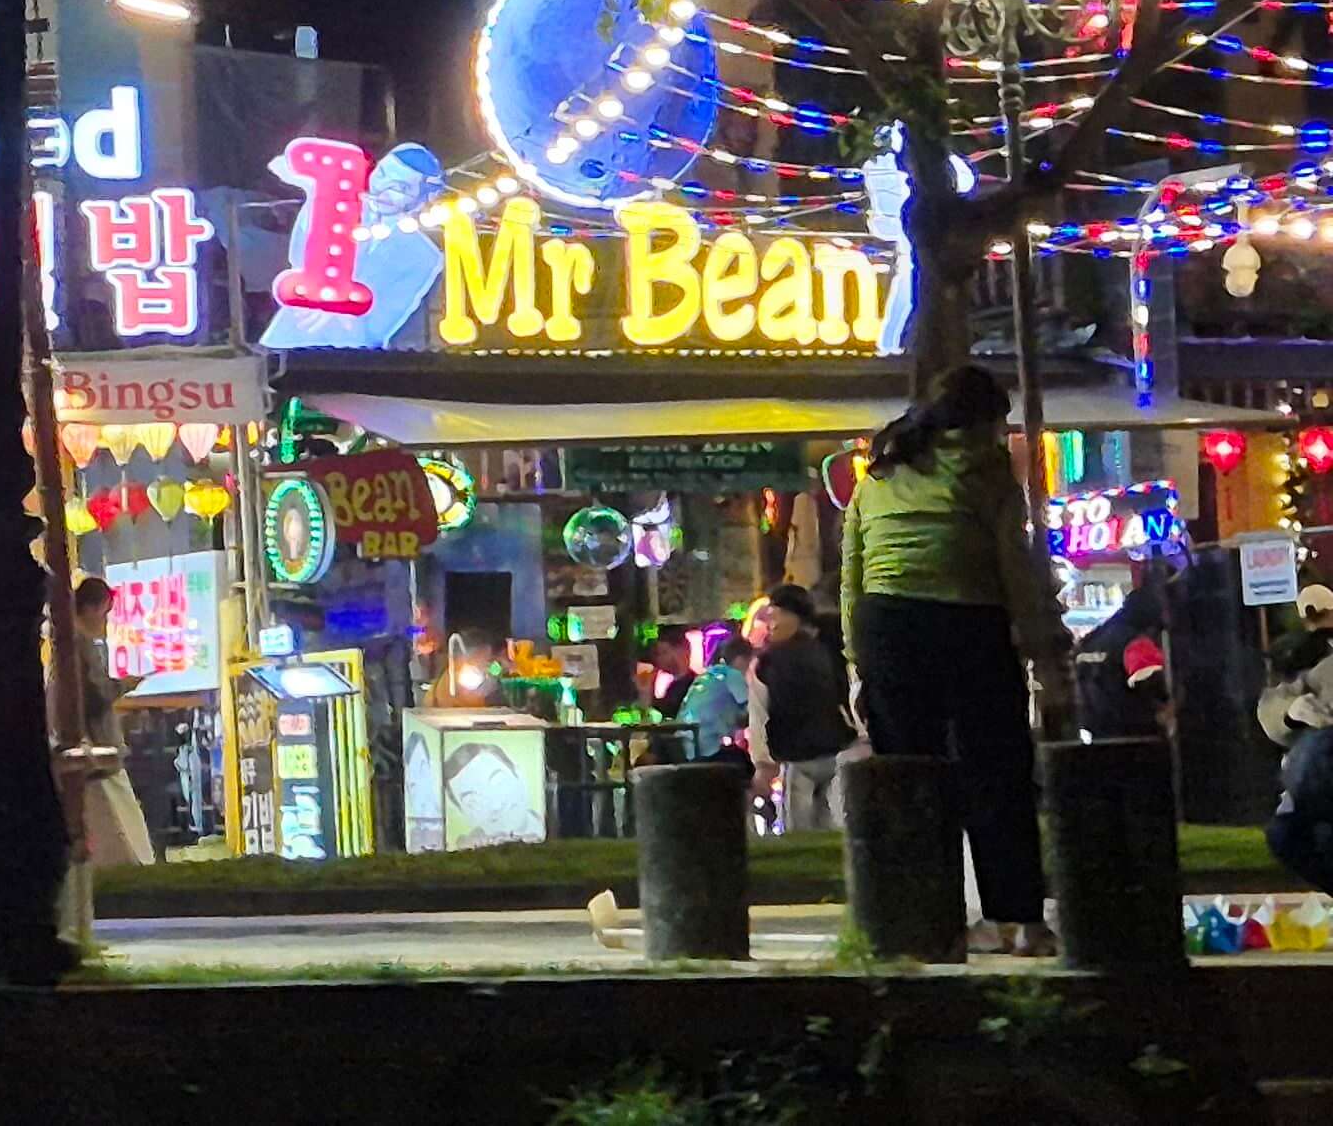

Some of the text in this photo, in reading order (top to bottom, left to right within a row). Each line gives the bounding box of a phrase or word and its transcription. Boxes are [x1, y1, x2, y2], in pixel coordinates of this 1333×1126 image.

[438, 196, 887, 347] Mr Bean
[62, 368, 235, 420] Bingsu
[324, 469, 422, 527] Bean
[362, 530, 420, 559] BAR
